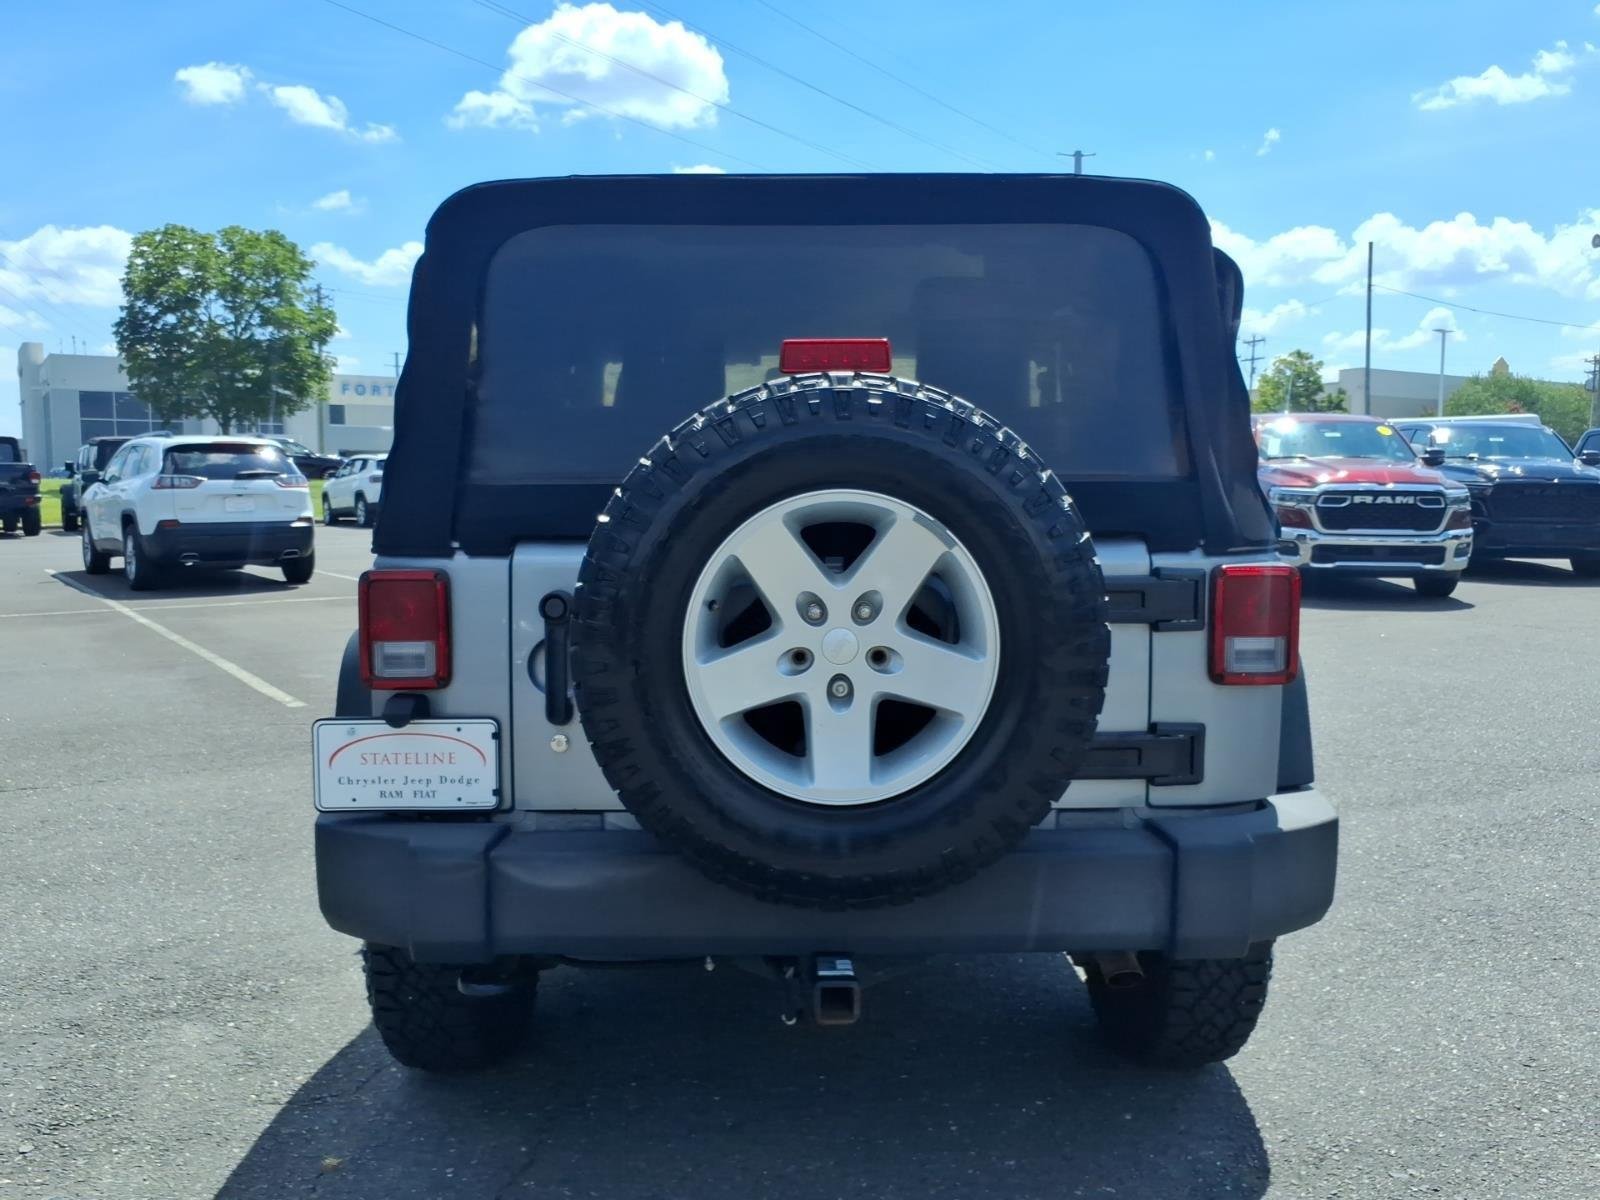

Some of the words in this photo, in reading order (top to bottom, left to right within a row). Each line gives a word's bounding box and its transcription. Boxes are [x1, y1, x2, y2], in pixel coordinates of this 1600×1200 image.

[341, 383, 395, 397] FORT
[1353, 495, 1415, 504] RAM
[360, 752, 457, 766] STATELINE
[337, 776, 396, 787] Chrysler
[402, 776, 433, 787] Jeep
[439, 775, 481, 786] Dodge
[379, 790, 404, 799] RAM
[413, 790, 438, 799] FIAT
